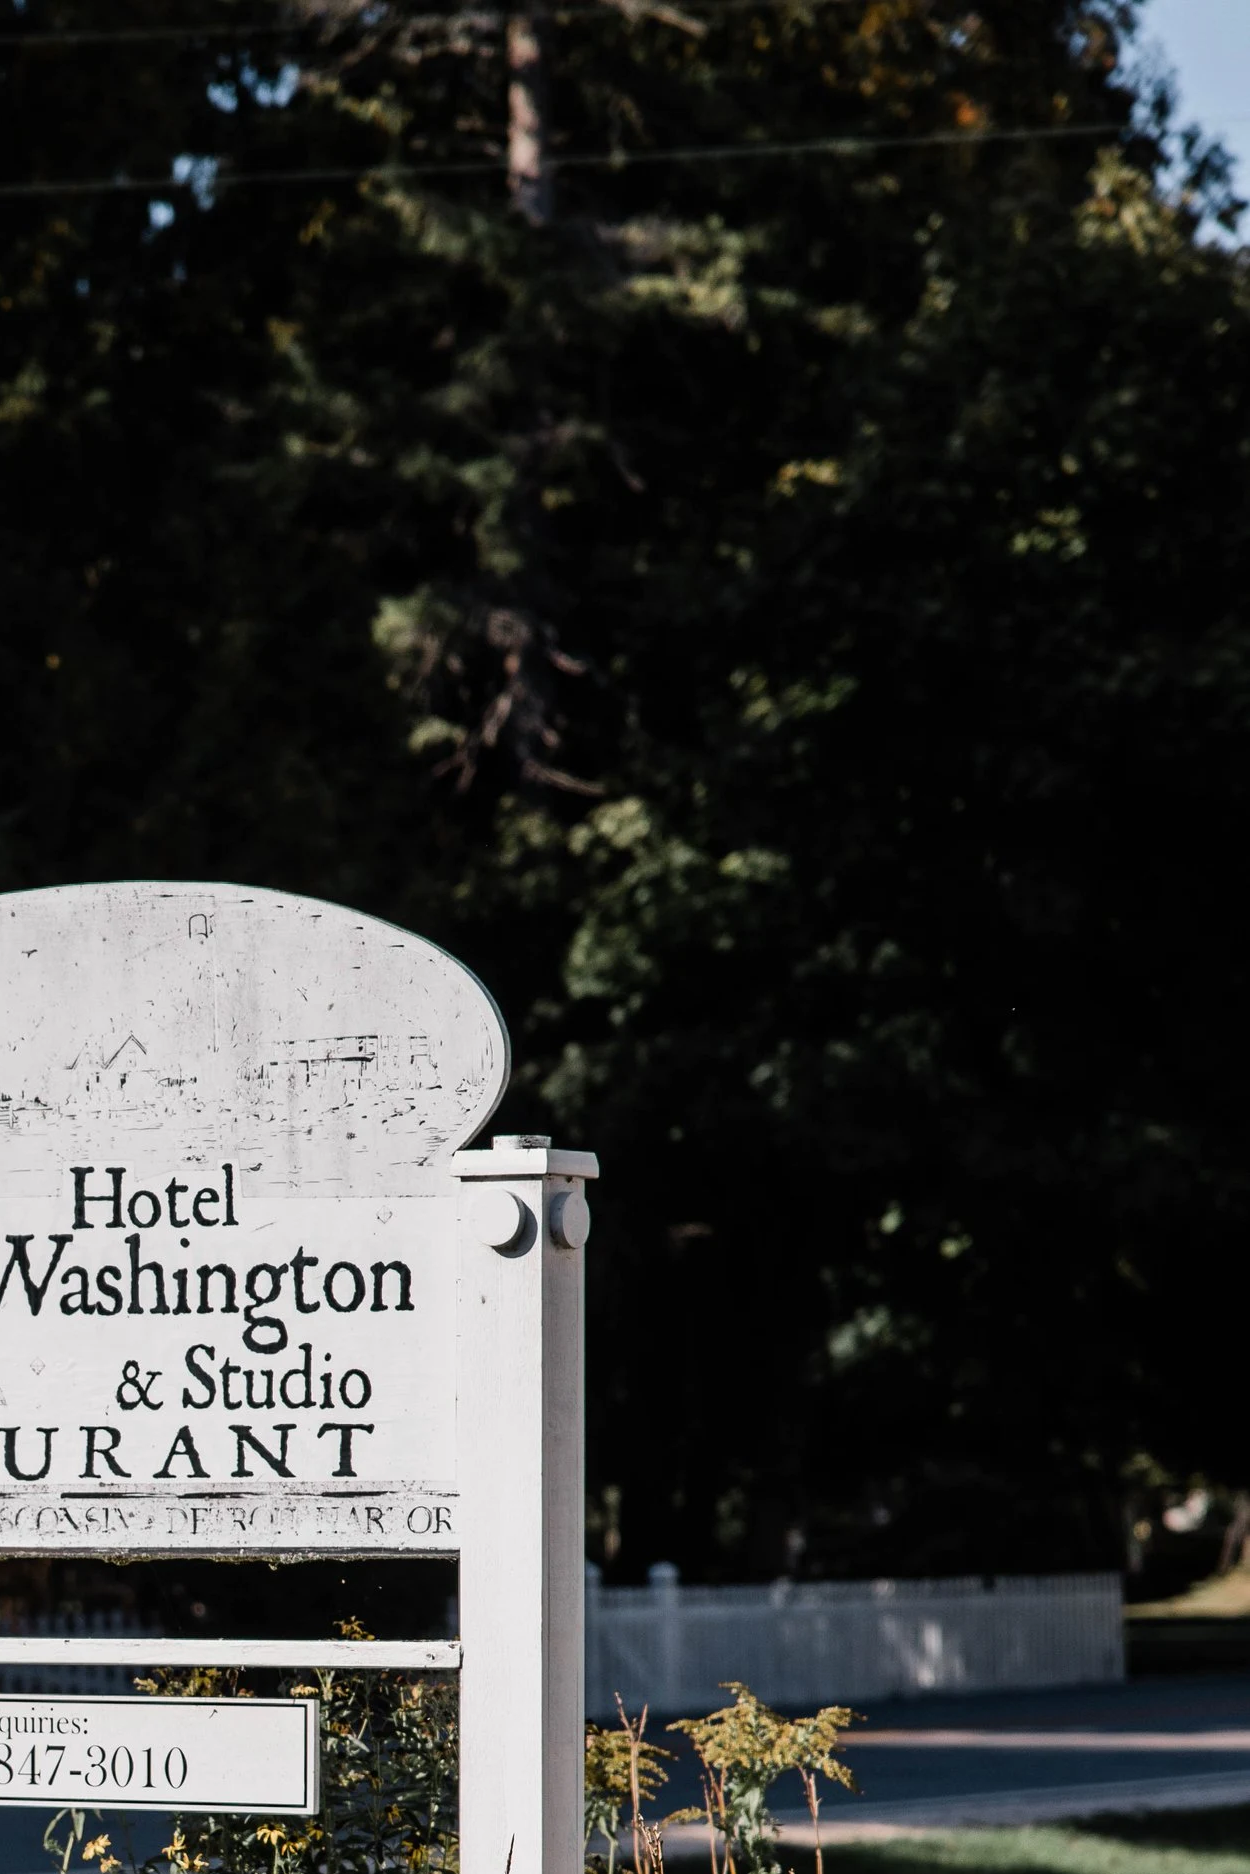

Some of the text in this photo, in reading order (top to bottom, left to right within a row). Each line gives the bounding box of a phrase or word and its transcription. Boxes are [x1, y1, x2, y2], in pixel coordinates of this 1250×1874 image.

[70, 1163, 239, 1231] Hotel
[116, 1342, 372, 1411] & Studio
[316, 1506, 454, 1534] HAROR
